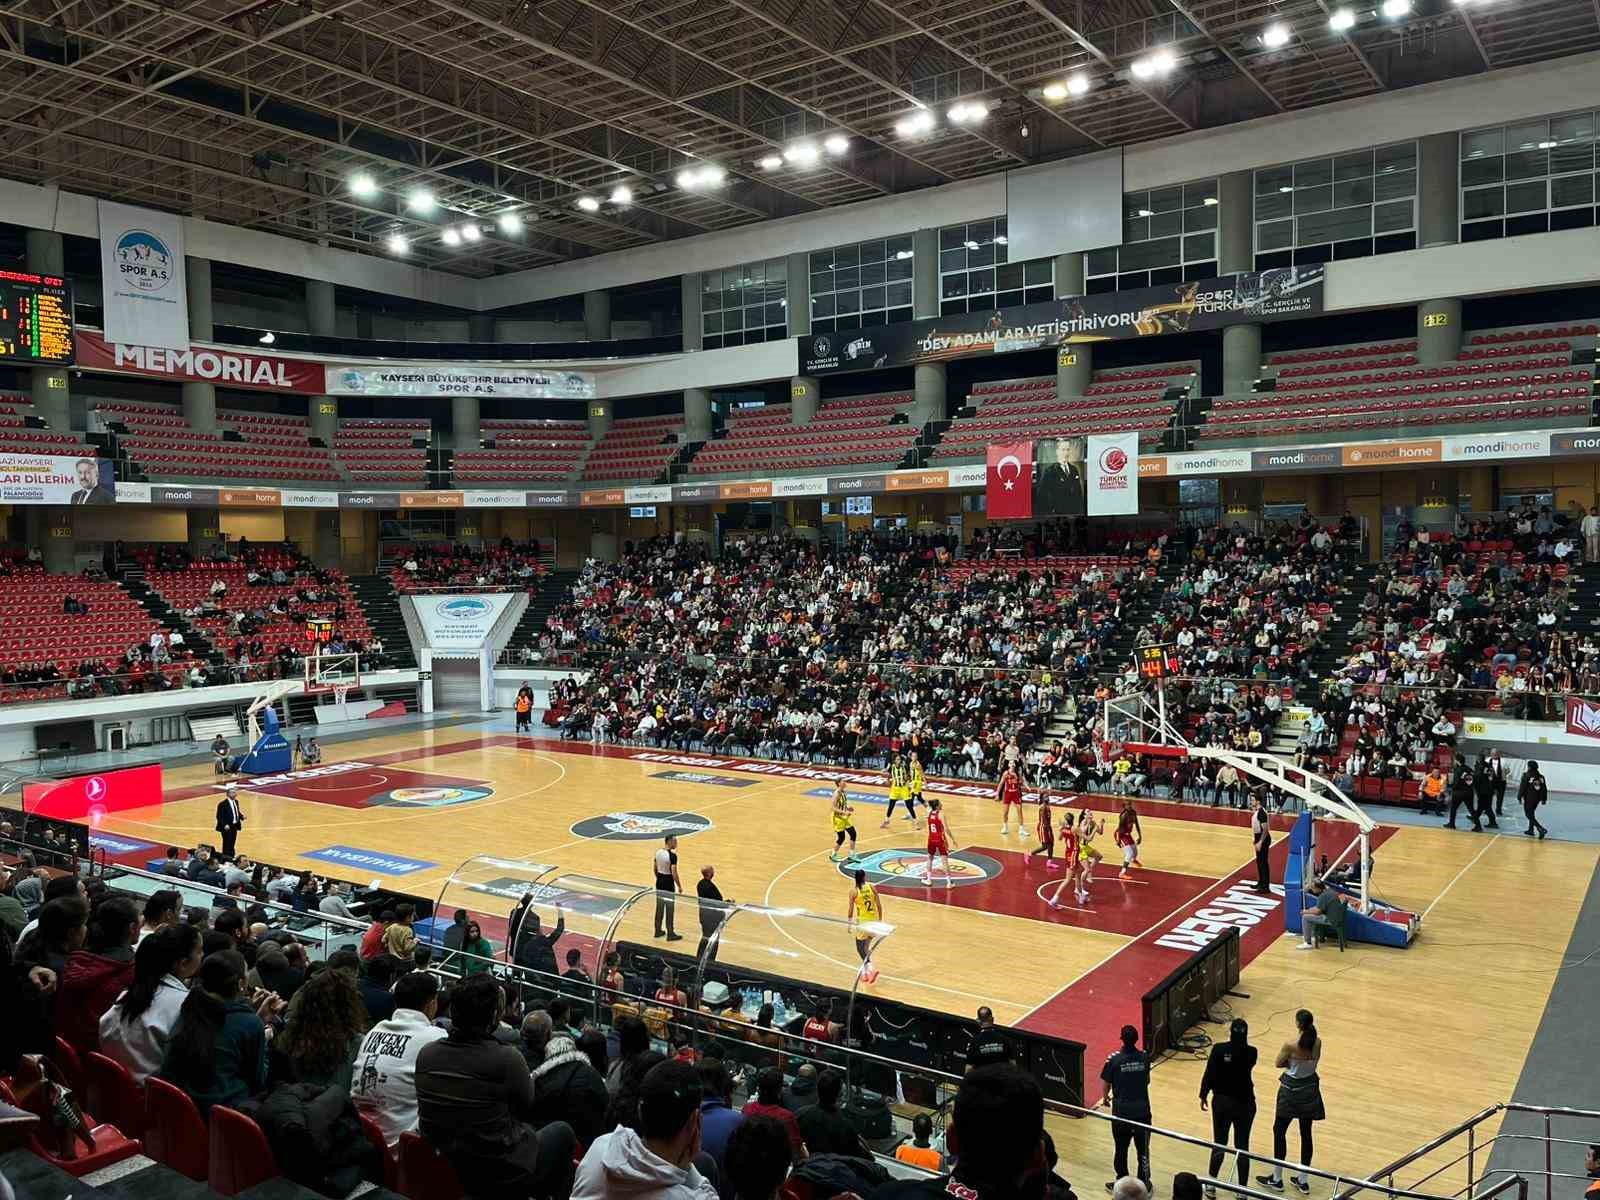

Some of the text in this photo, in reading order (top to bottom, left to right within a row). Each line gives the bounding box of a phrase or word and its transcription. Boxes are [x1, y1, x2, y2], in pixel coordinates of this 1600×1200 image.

[120, 264, 147, 276] SPOR
[114, 344, 293, 388] MEMORIAL
[1361, 446, 1433, 460] mondihome
[1463, 439, 1540, 455] mondihome
[1184, 456, 1245, 469] mondihome
[1269, 452, 1334, 465] mondihome
[25, 473, 75, 485] DİLERİM
[864, 900, 875, 912] 2
